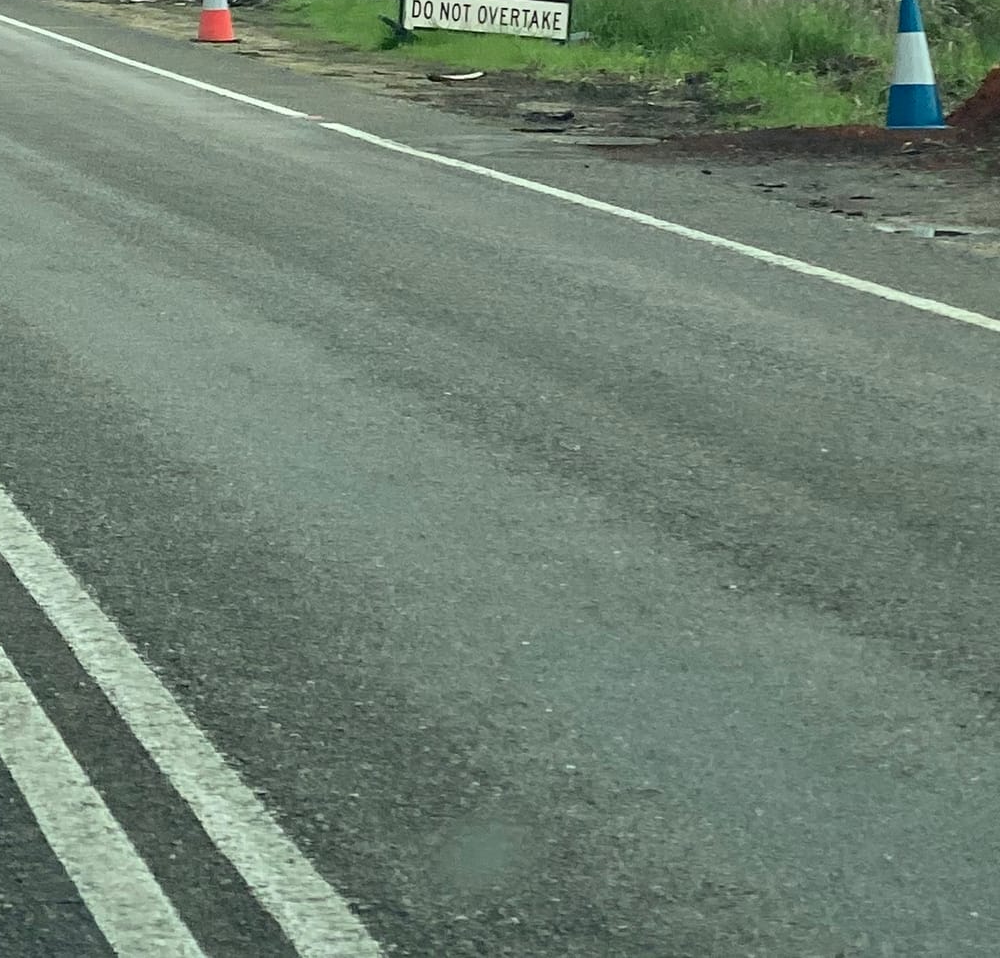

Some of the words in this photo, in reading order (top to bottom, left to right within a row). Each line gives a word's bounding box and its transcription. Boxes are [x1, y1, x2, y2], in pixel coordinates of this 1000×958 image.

[411, 0, 434, 20] DO
[439, 1, 472, 22] NOT
[477, 5, 563, 31] OVERTAKE
